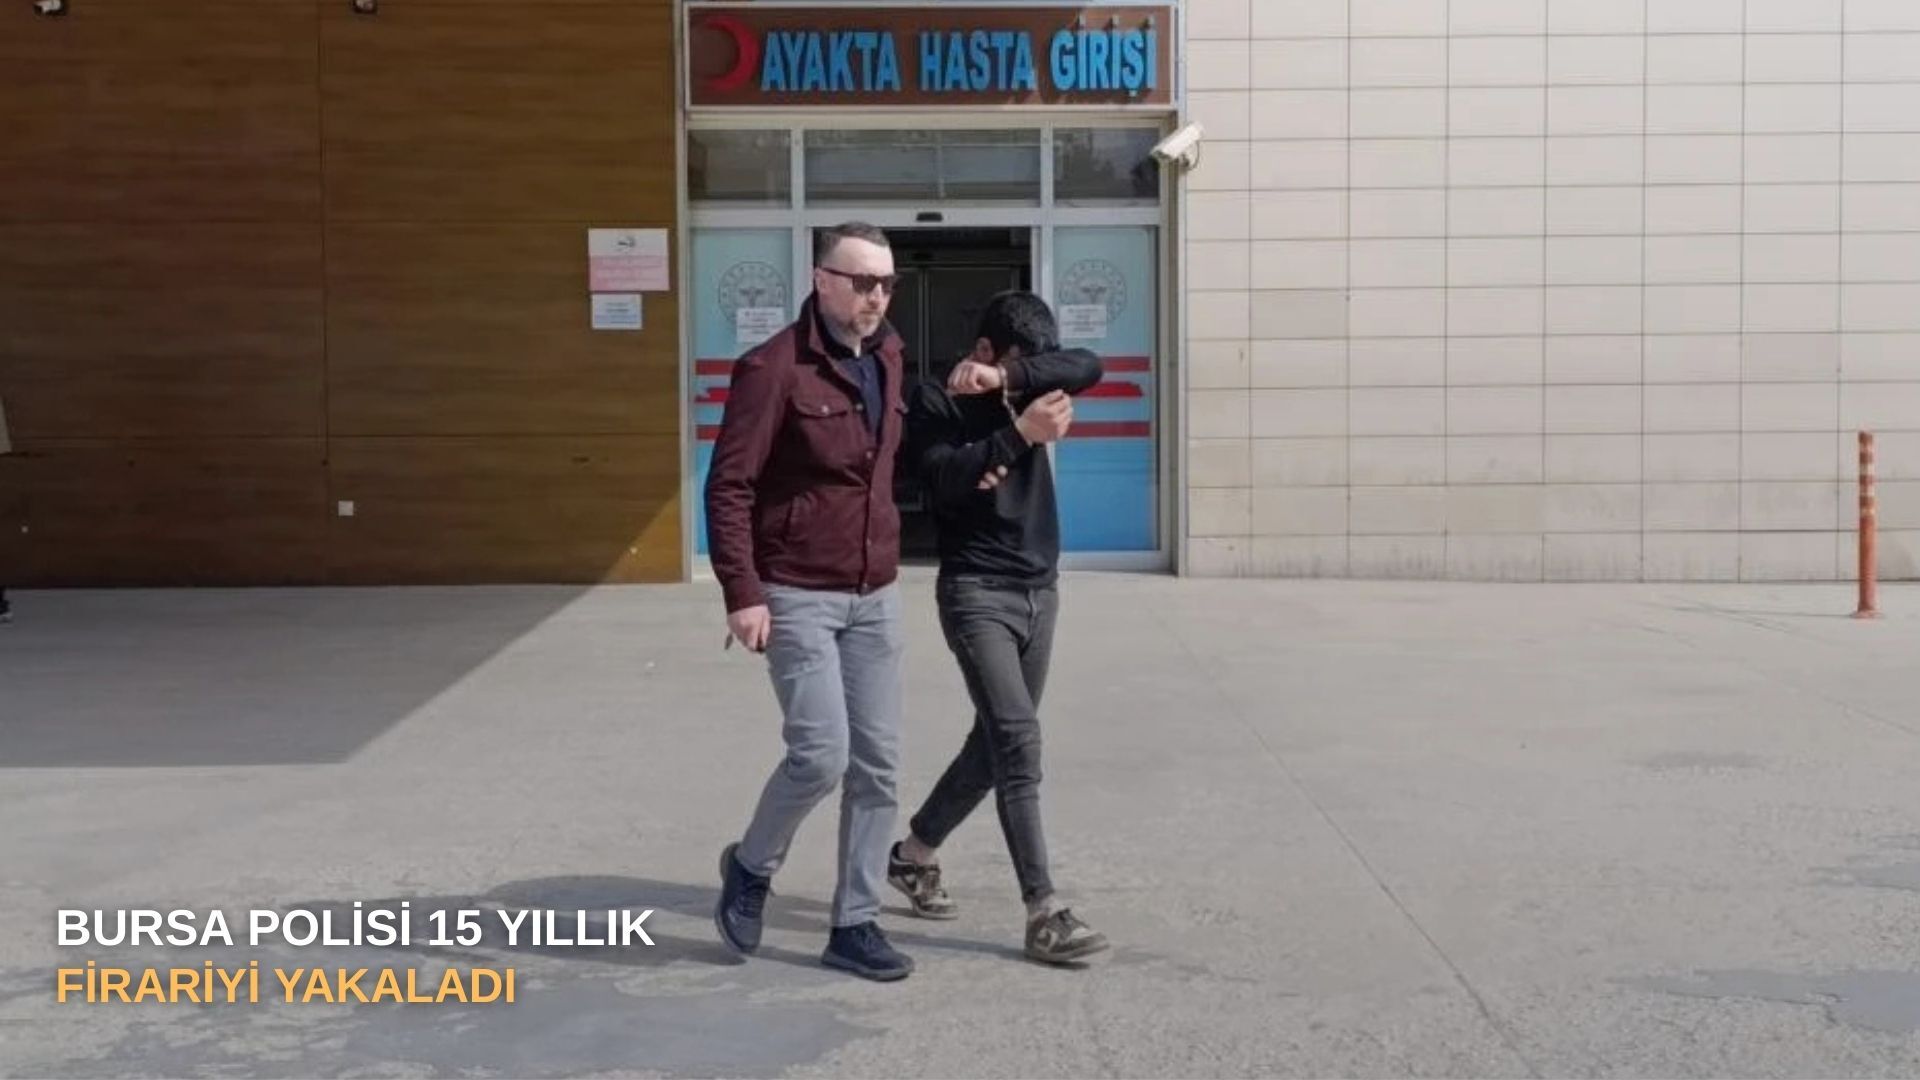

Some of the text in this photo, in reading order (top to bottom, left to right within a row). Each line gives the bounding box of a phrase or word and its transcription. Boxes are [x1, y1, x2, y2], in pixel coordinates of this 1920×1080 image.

[761, 16, 1157, 97] AYAKTA HASTA GİRİŞİ
